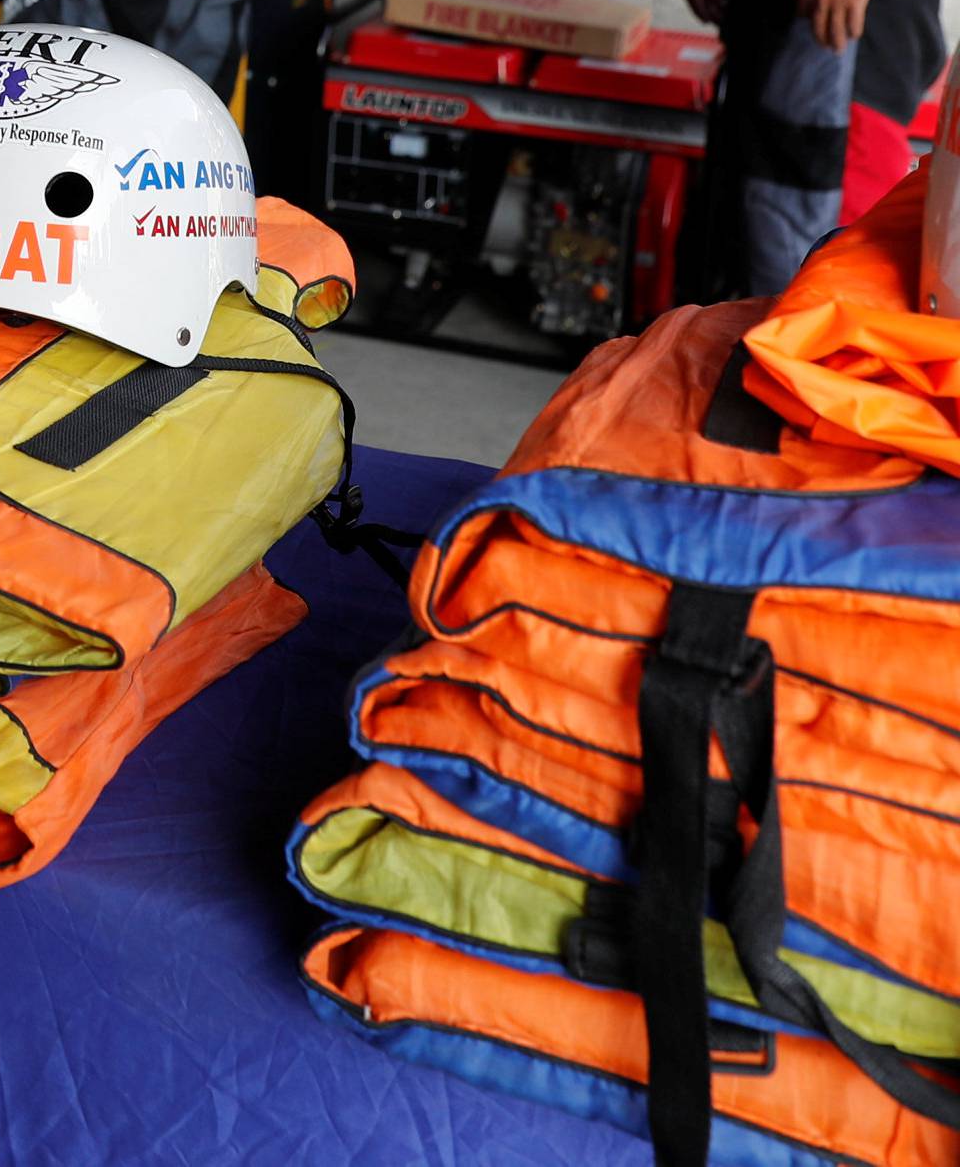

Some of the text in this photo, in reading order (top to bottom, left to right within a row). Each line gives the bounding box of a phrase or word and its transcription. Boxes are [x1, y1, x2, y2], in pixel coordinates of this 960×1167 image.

[10, 123, 68, 145] Response
[72, 129, 104, 151] Team
[195, 161, 233, 189] ANG
[186, 215, 217, 237] ANG
